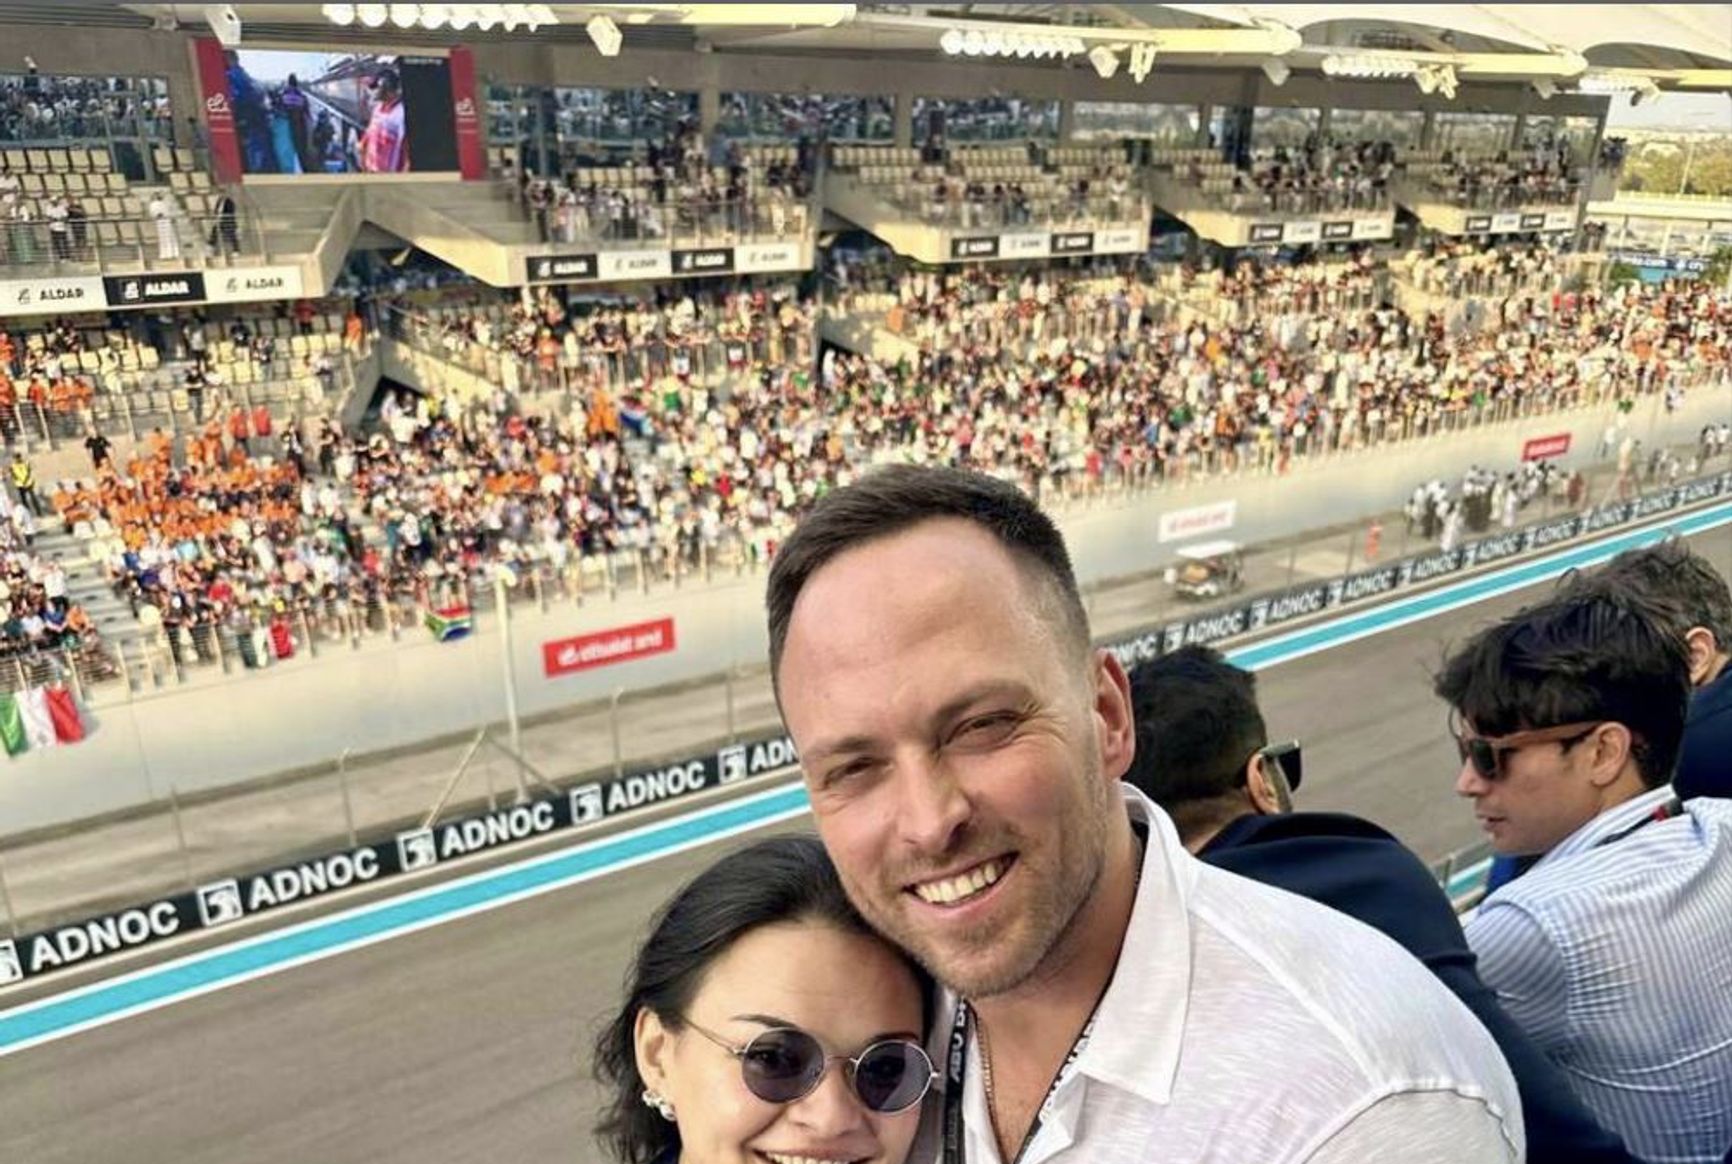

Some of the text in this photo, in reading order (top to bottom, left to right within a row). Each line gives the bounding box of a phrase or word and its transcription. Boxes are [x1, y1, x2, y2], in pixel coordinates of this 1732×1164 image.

[39, 288, 85, 301] ALDAR
[145, 281, 190, 297] ALDAR
[245, 277, 285, 290] ALDAR
[1270, 590, 1323, 618] ADNOC
[1185, 612, 1244, 643] ADNOC
[750, 737, 799, 772] ADN
[607, 761, 706, 812] ADNOC
[442, 802, 555, 857] ADNOC
[249, 849, 380, 910] ADNOC
[31, 902, 180, 971] ADNOC
[949, 1033, 964, 1084] ABU
